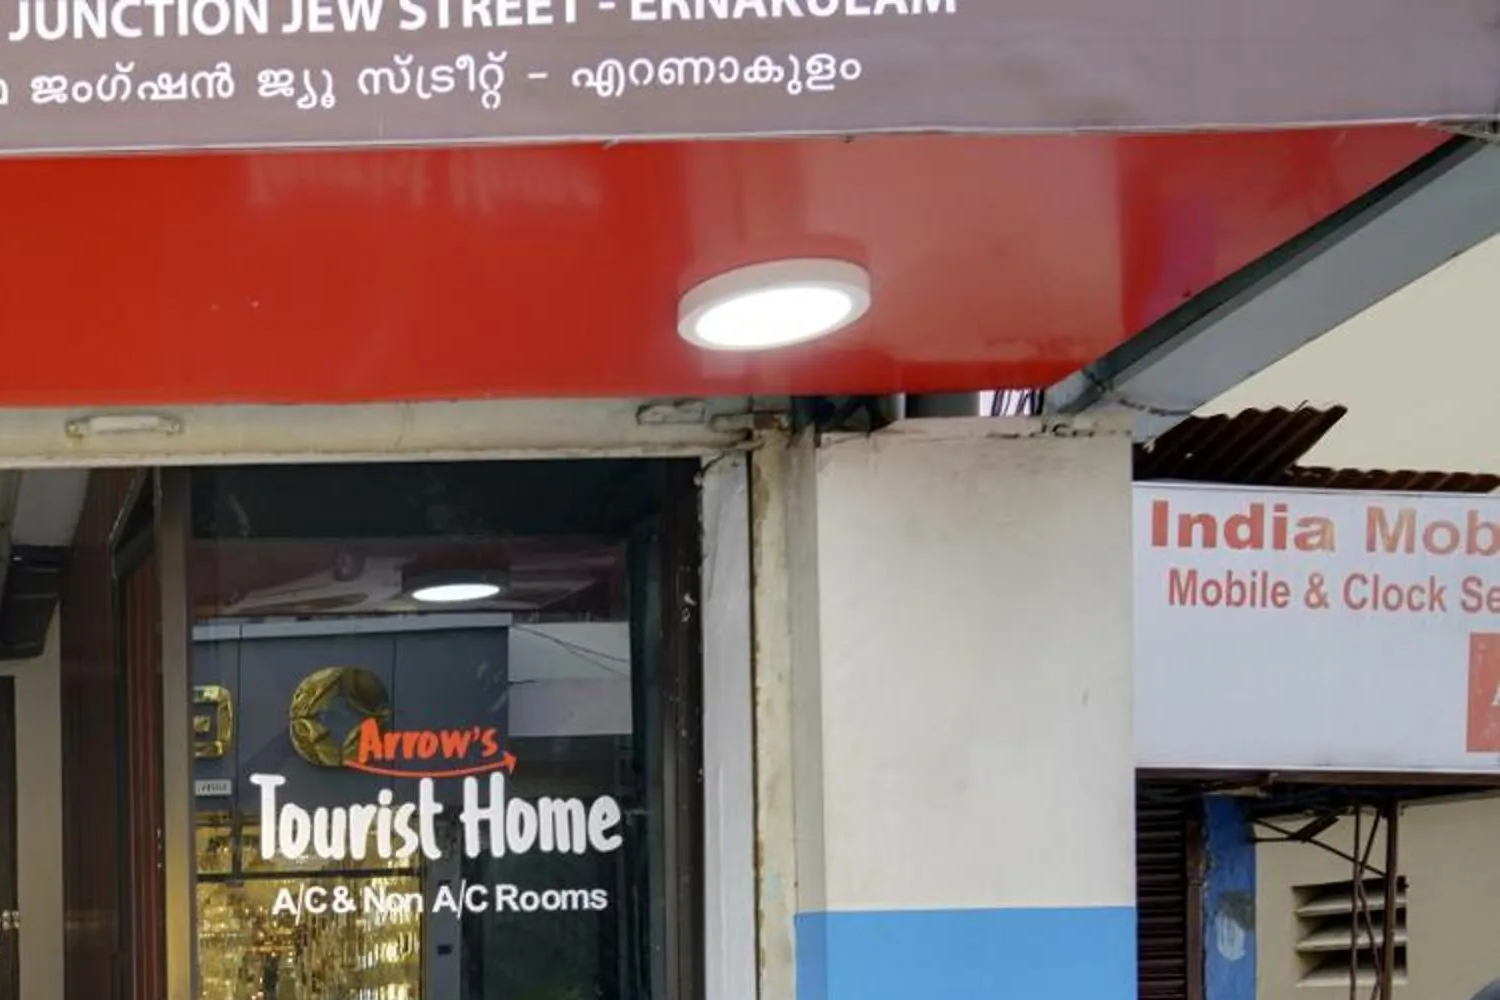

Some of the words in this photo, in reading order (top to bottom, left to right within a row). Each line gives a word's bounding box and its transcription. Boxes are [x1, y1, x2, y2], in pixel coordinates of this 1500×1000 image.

[8, 0, 269, 42] JUNCTION
[282, 0, 384, 33] JEW
[30, 61, 235, 104] ജംഗ്ഷൻ
[571, 53, 862, 97] എറണാകുളം
[1151, 500, 1336, 553] India
[1366, 505, 1500, 556] Mob
[1168, 568, 1291, 609] Mobile
[1304, 572, 1330, 609] &
[1343, 572, 1448, 613] Clock
[1460, 576, 1500, 614] Se
[358, 717, 498, 764] Arrow's
[250, 772, 444, 861] Tourist
[459, 771, 624, 859] Home
[363, 885, 424, 913] Non
[432, 879, 489, 920] A/C
[495, 884, 609, 913] Rooms
